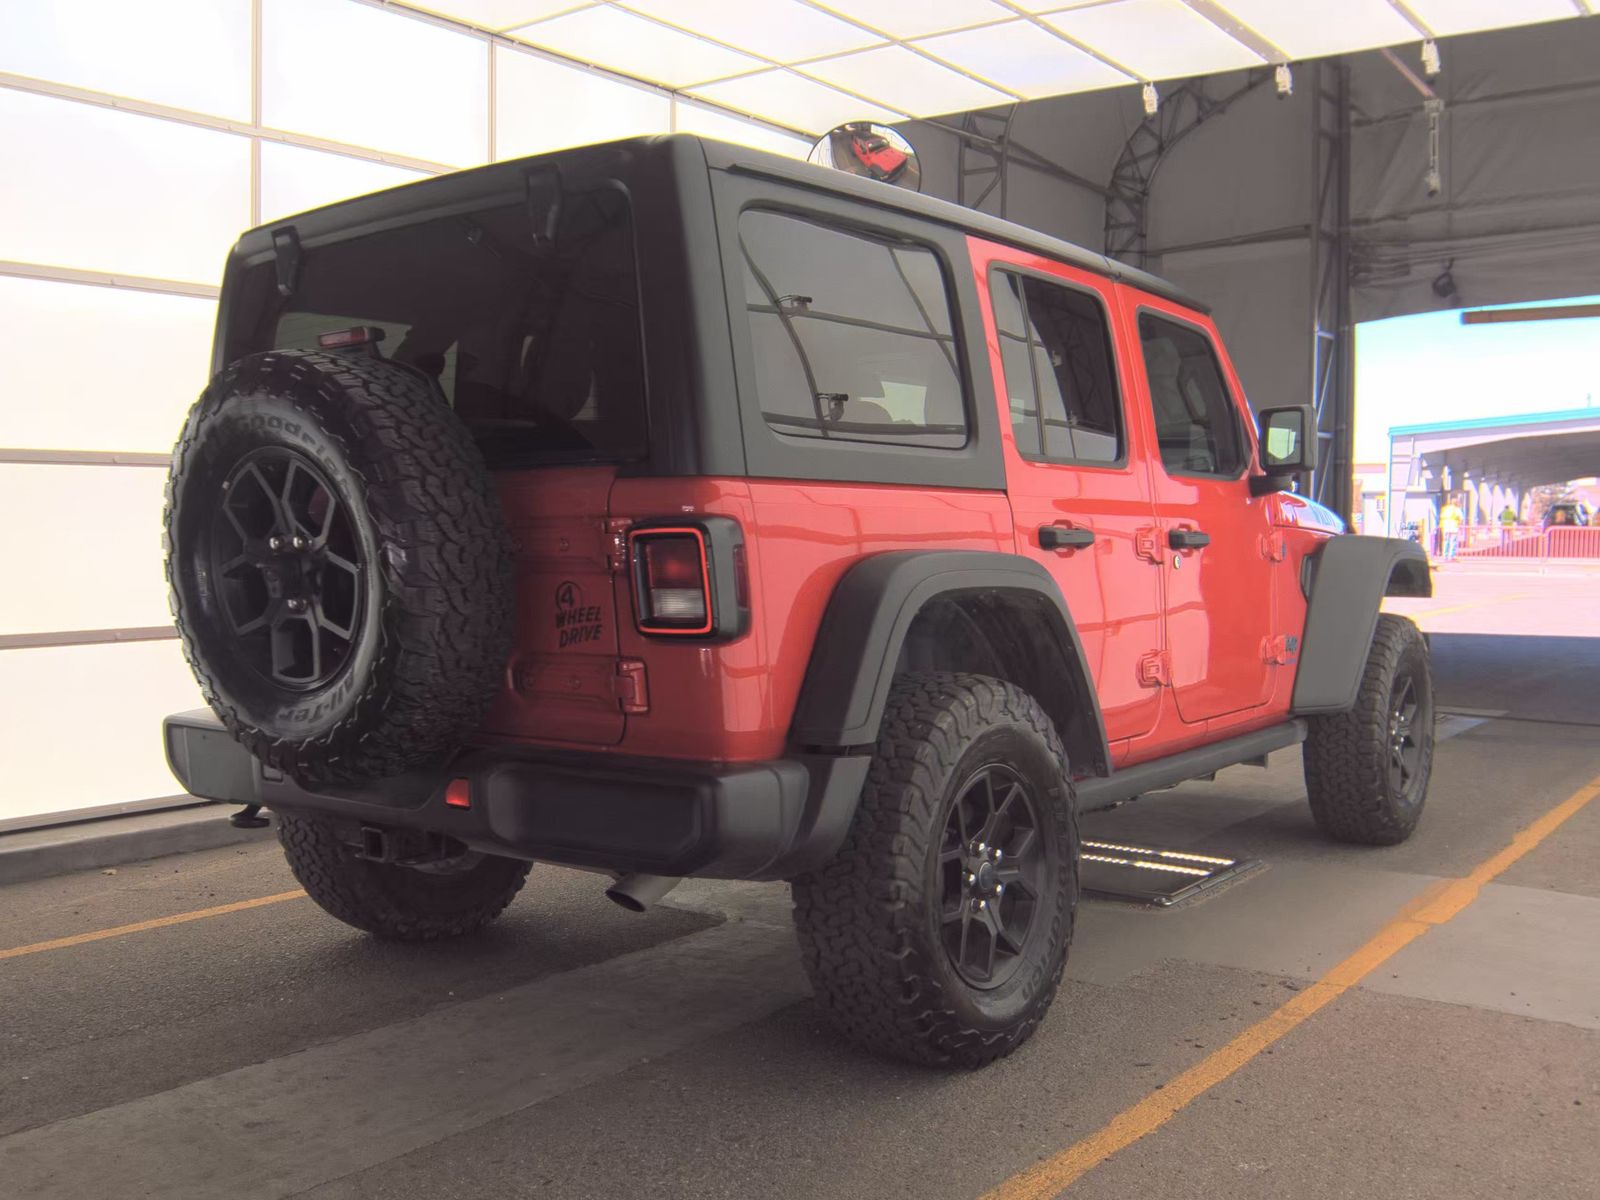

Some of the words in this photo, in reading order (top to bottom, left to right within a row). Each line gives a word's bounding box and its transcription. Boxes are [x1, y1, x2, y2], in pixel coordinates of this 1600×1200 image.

[561, 585, 575, 609] 4
[556, 606, 602, 629] WHEEL
[559, 624, 603, 648] DRIVE
